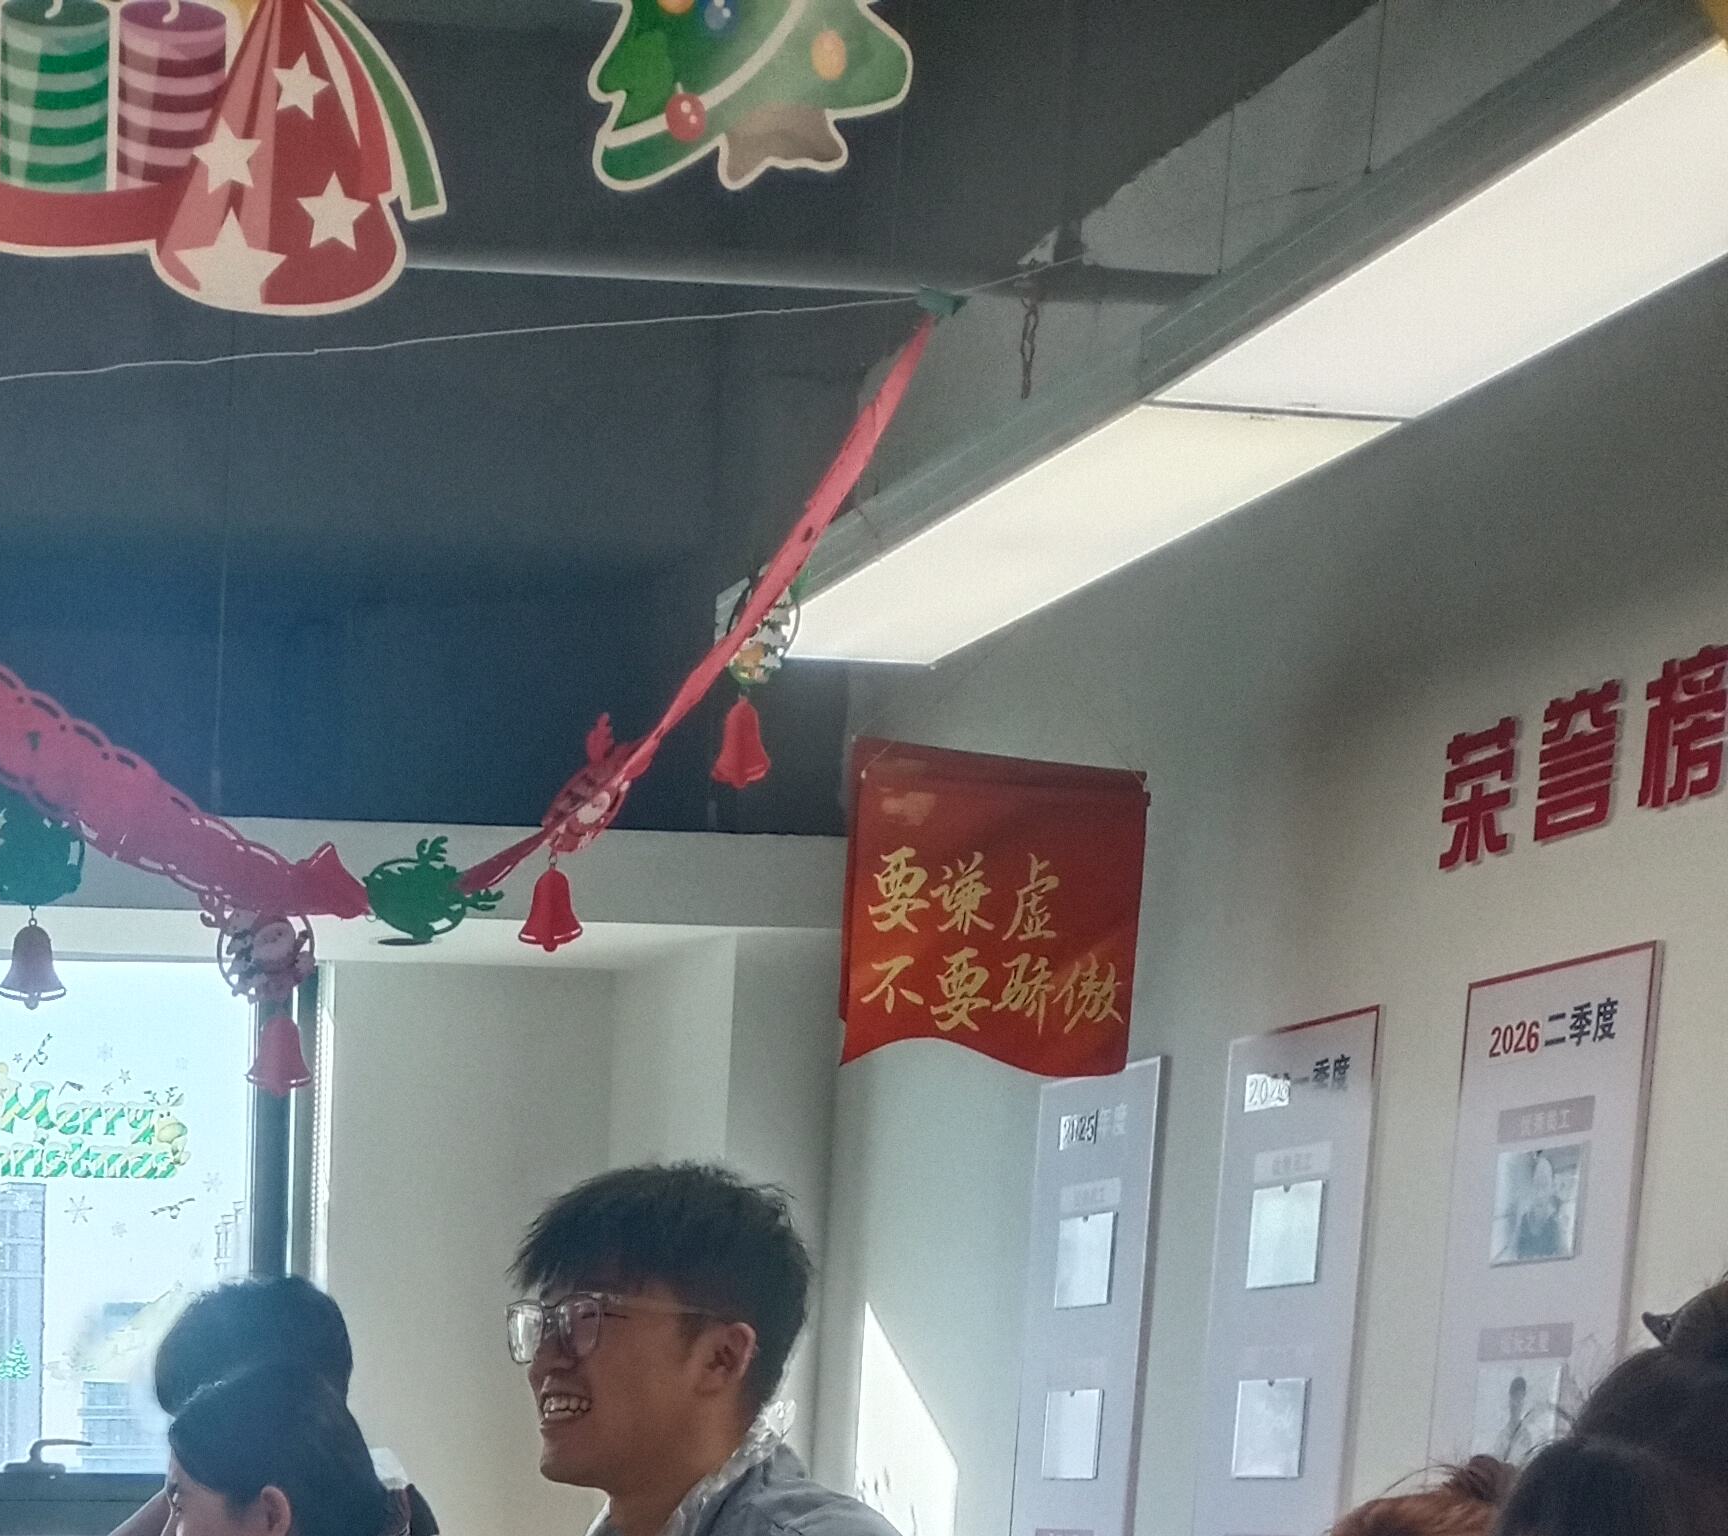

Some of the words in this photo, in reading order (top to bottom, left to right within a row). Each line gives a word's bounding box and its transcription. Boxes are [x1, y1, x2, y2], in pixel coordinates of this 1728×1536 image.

[1439, 644, 1728, 870] 荣誉榜
[868, 846, 1060, 943] 要谦虚
[861, 947, 1125, 1036] 不要骄傲
[1488, 1020, 1540, 1058] 2026
[1544, 997, 1619, 1048] 二季度
[0, 1080, 160, 1144] Merry
